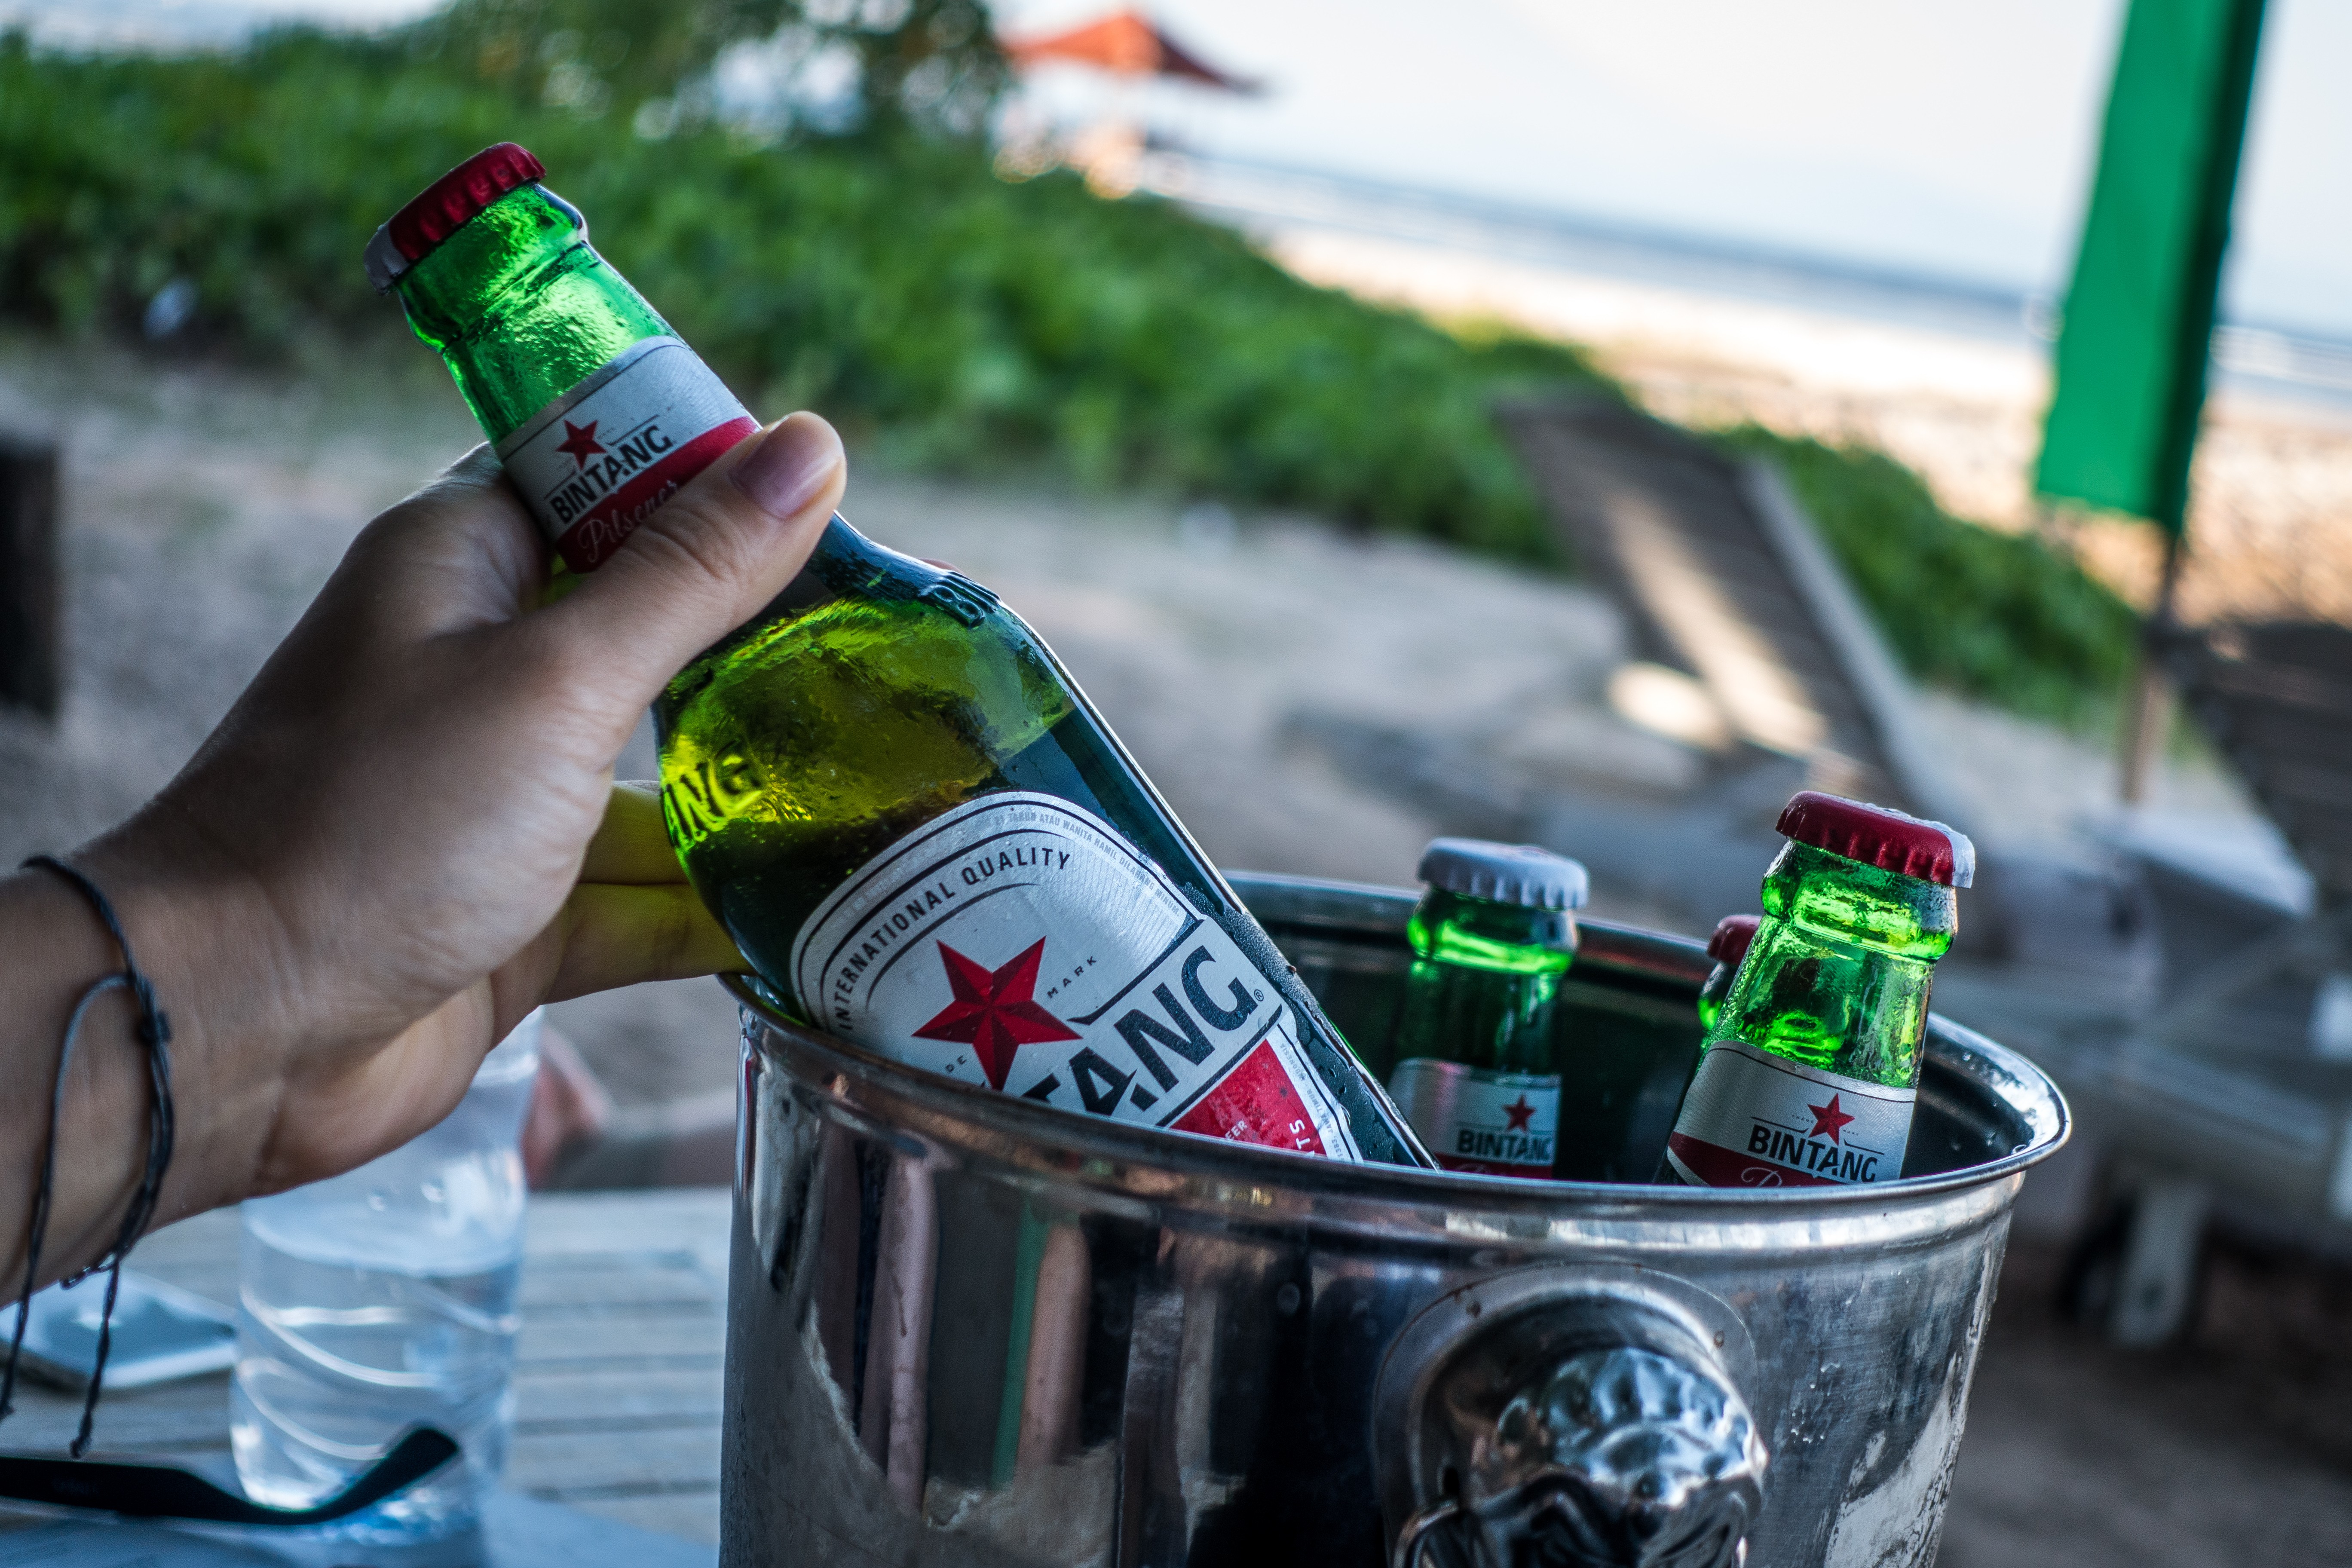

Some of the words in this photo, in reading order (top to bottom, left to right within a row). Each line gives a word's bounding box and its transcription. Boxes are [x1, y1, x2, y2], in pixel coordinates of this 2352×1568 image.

[549, 425, 674, 524] BINTANG
[1039, 813, 1060, 826] ATAU
[1063, 820, 1093, 842] WANITA
[1094, 838, 1117, 860] HAMIL
[1119, 858, 1155, 890] DILARANG
[834, 882, 956, 1030] INTERNATIONAL
[961, 847, 1071, 885] QUALITY
[1047, 955, 1097, 1000] MARK
[945, 1055, 967, 1073] DE
[1307, 1088, 1323, 1113] TIMUR
[1225, 1119, 1247, 1140] EER
[1747, 1124, 1878, 1183] BINTANG
